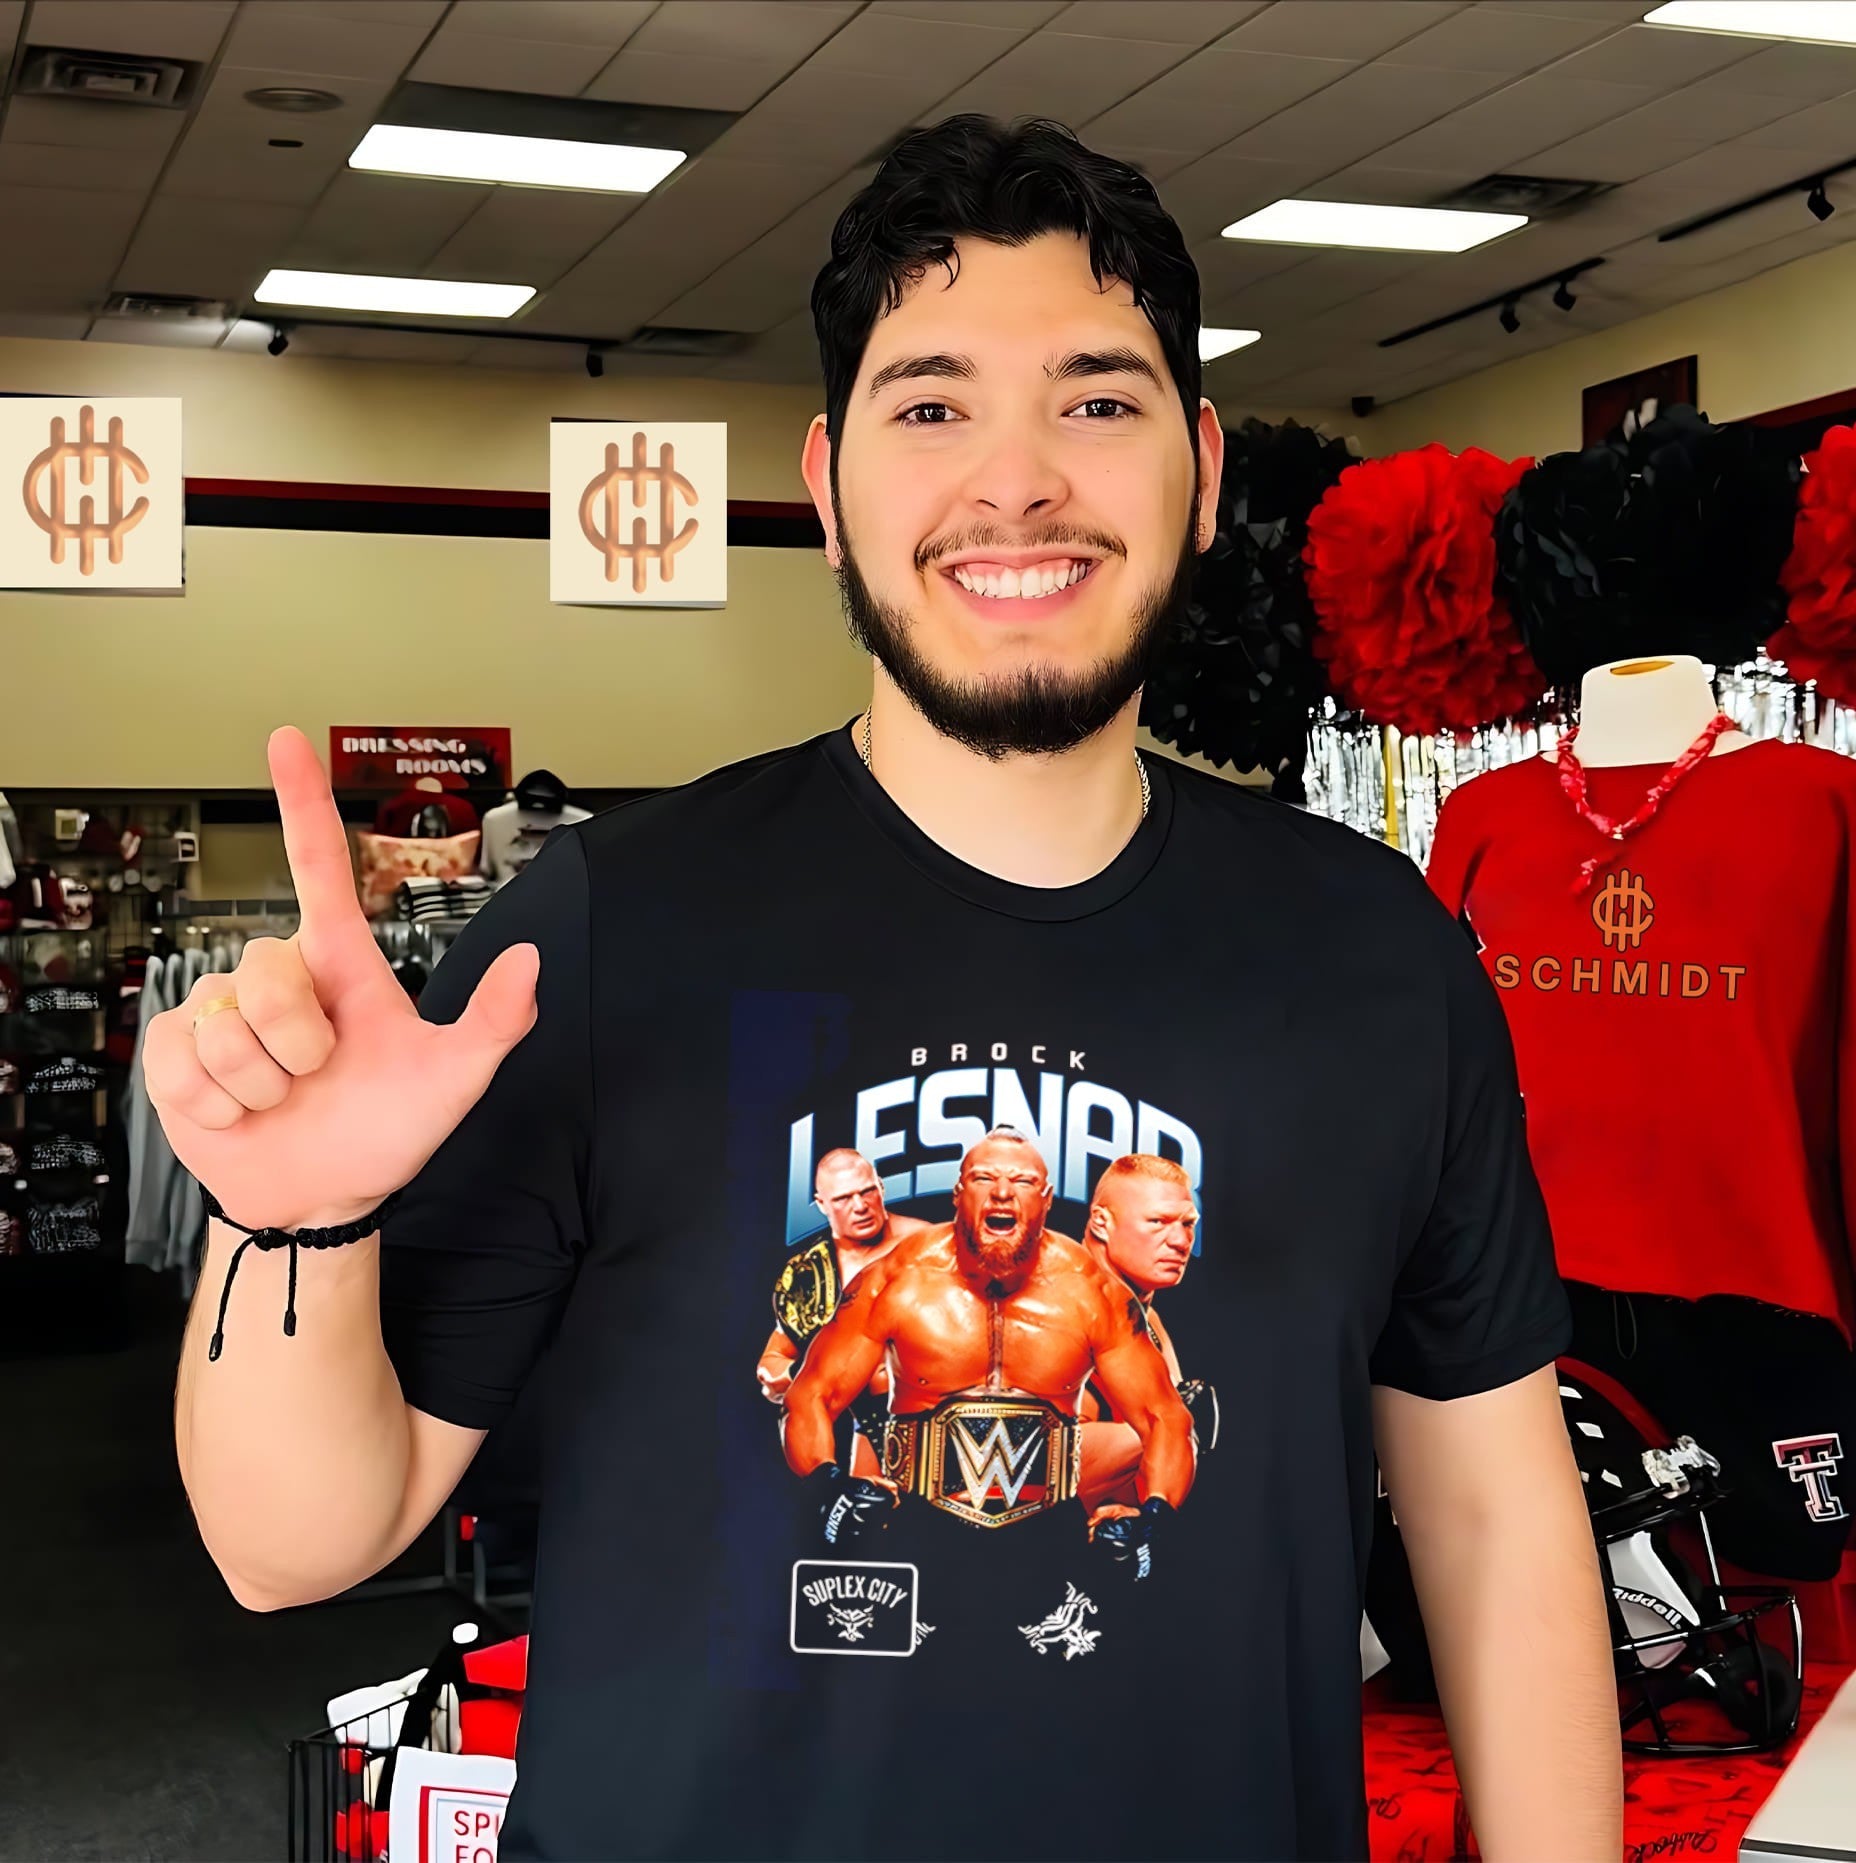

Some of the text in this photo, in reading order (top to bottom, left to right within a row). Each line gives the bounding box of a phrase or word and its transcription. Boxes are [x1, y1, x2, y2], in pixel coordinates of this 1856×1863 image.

[342, 737, 467, 753] DRESSING
[396, 758, 487, 775] ROOMS
[1494, 953, 1747, 1001] SCHMIDT
[911, 1042, 1086, 1071] BROCK
[785, 1067, 1204, 1258] LESNAR
[802, 1575, 909, 1609] SUPLEX CITY
